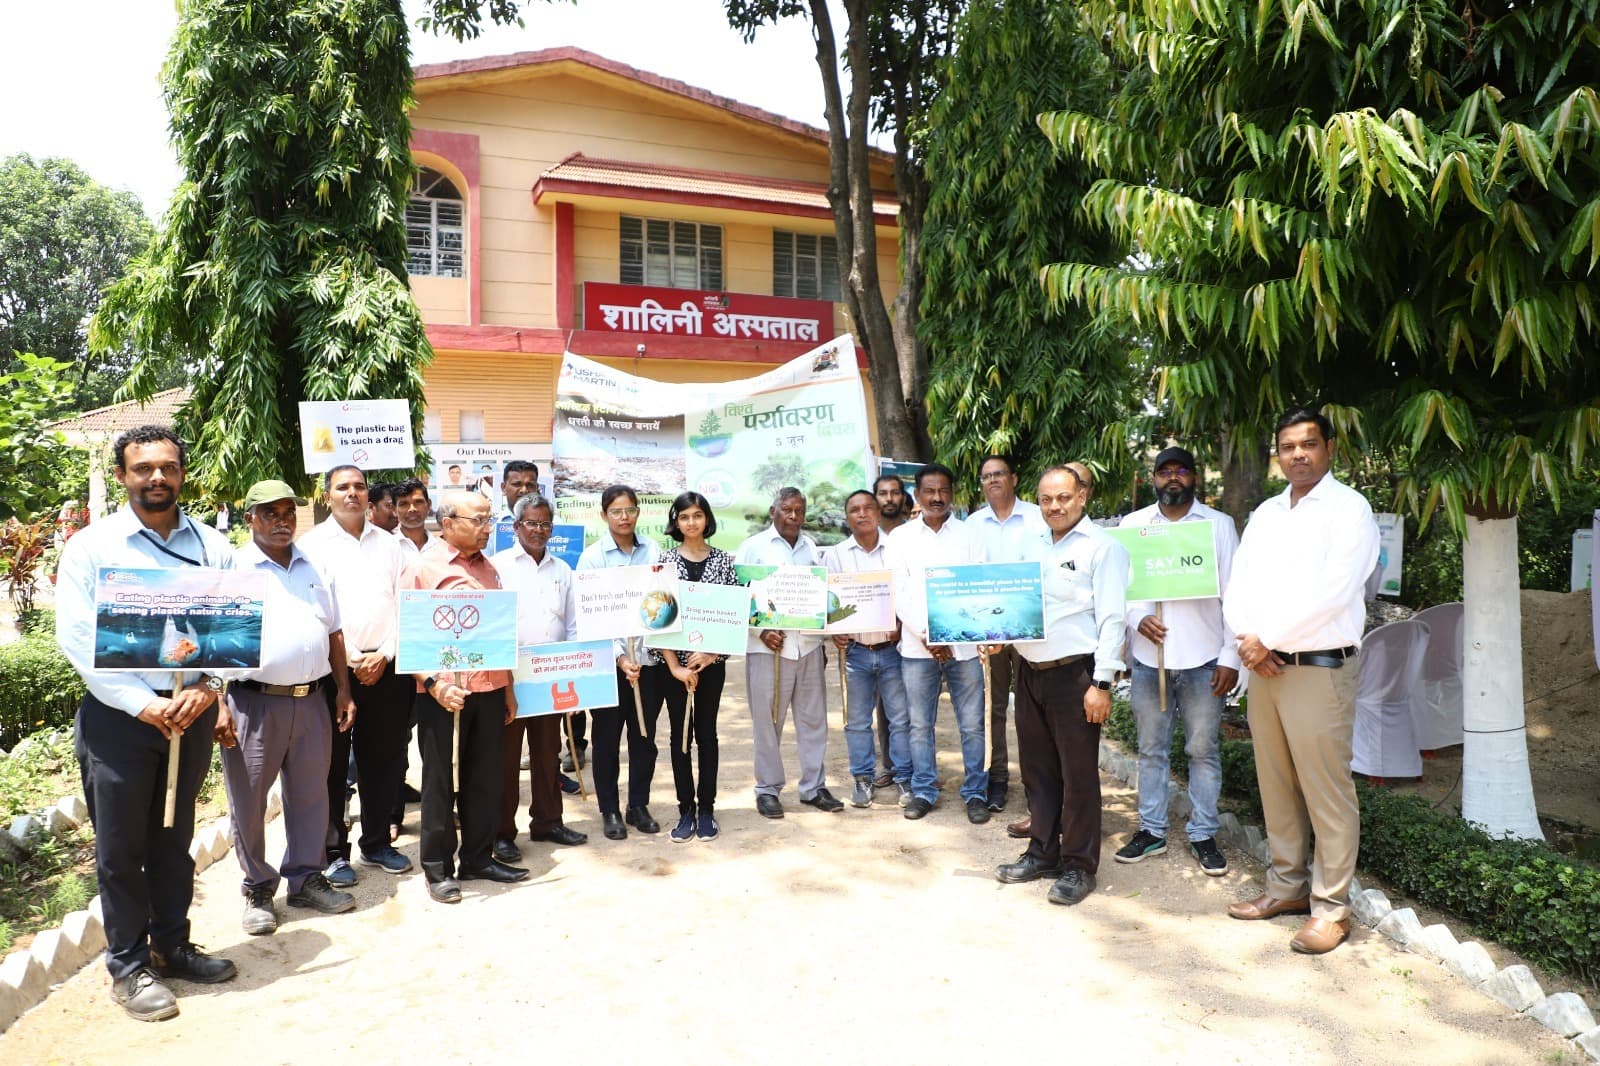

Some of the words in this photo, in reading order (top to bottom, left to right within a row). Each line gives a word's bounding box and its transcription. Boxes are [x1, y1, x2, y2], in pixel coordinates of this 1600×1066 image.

[599, 299, 703, 335] शालिनी
[712, 312, 819, 342] अस्पताल
[723, 402, 755, 417] विश्व
[567, 415, 591, 427] धरती
[592, 417, 605, 428] को
[607, 420, 633, 430] स्वच्छ
[635, 419, 661, 431] बनायें
[742, 405, 835, 431] पर्यावरण
[336, 426, 353, 434] The
[355, 425, 386, 434] plastic
[388, 424, 406, 434] bag
[340, 437, 349, 445] is
[351, 436, 373, 445] such
[383, 435, 404, 445] drag
[775, 438, 782, 447] 5
[456, 447, 475, 456] Our
[478, 447, 512, 456] Doctors
[637, 496, 675, 506] ollution
[1145, 557, 1175, 570] SAY
[1180, 554, 1203, 567] NO
[116, 593, 152, 605] Eating
[153, 593, 191, 605] plastic
[192, 594, 233, 605] animals
[581, 593, 597, 603] Don't
[112, 607, 148, 617] seeing
[150, 607, 187, 617] plastic
[190, 607, 223, 616] nature
[225, 607, 253, 617] cries.
[581, 605, 593, 615] Say
[603, 604, 609, 612] to
